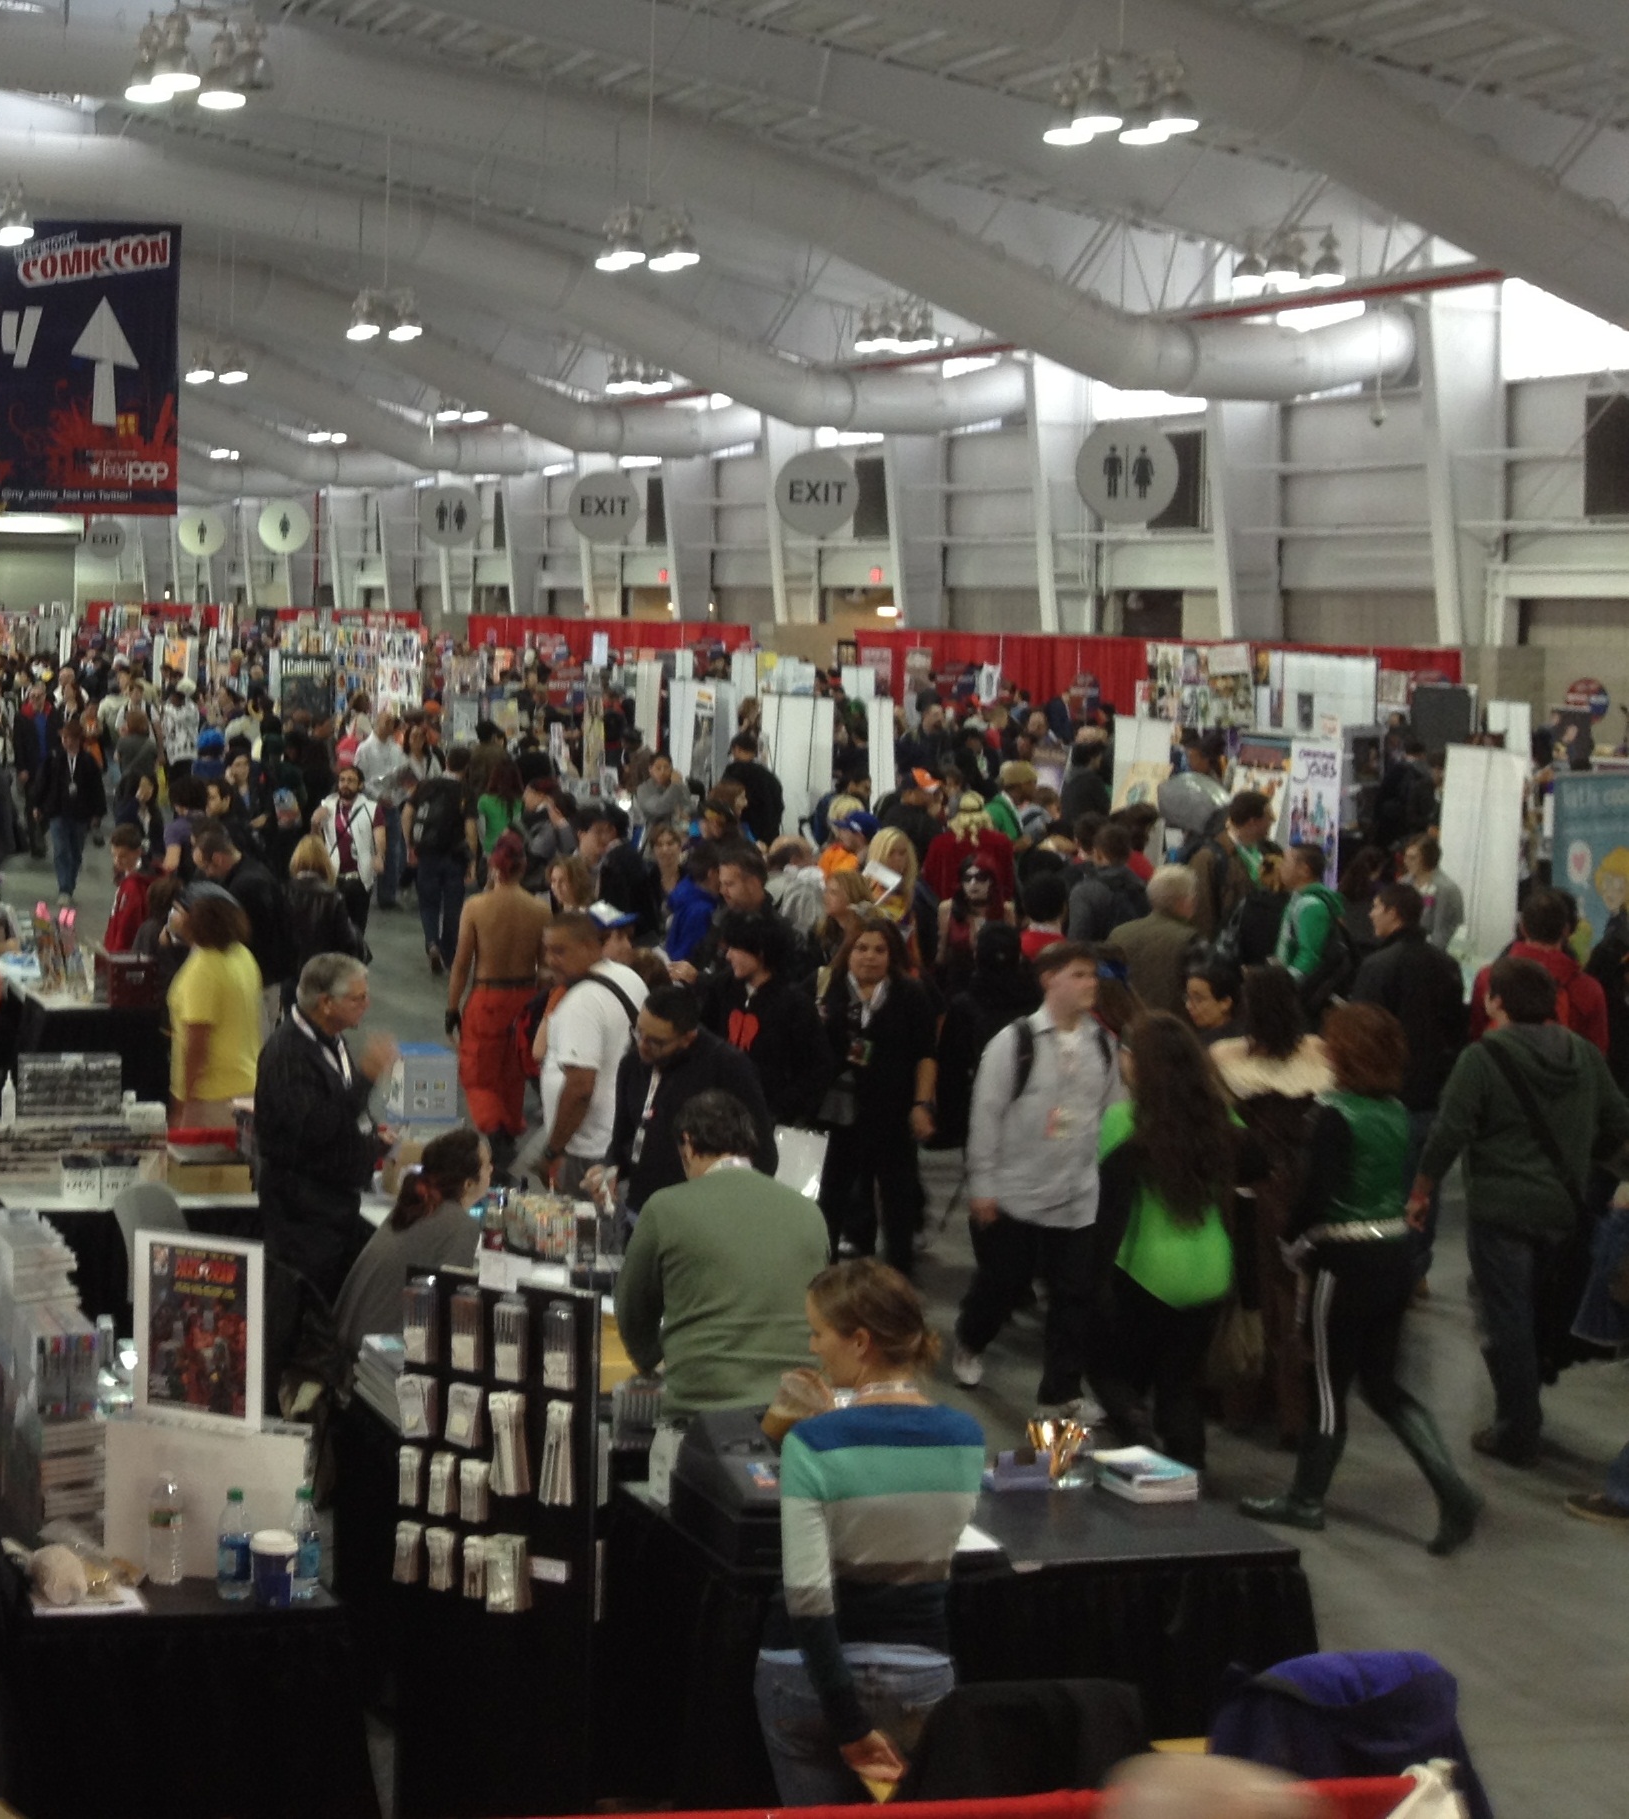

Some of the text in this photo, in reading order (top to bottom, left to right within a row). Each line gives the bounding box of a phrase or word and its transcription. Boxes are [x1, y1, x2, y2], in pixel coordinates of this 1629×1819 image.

[21, 236, 169, 283] COMIC CON
[788, 479, 848, 504] EXIT
[580, 496, 628, 516] EXIT
[92, 533, 119, 545] EXIT
